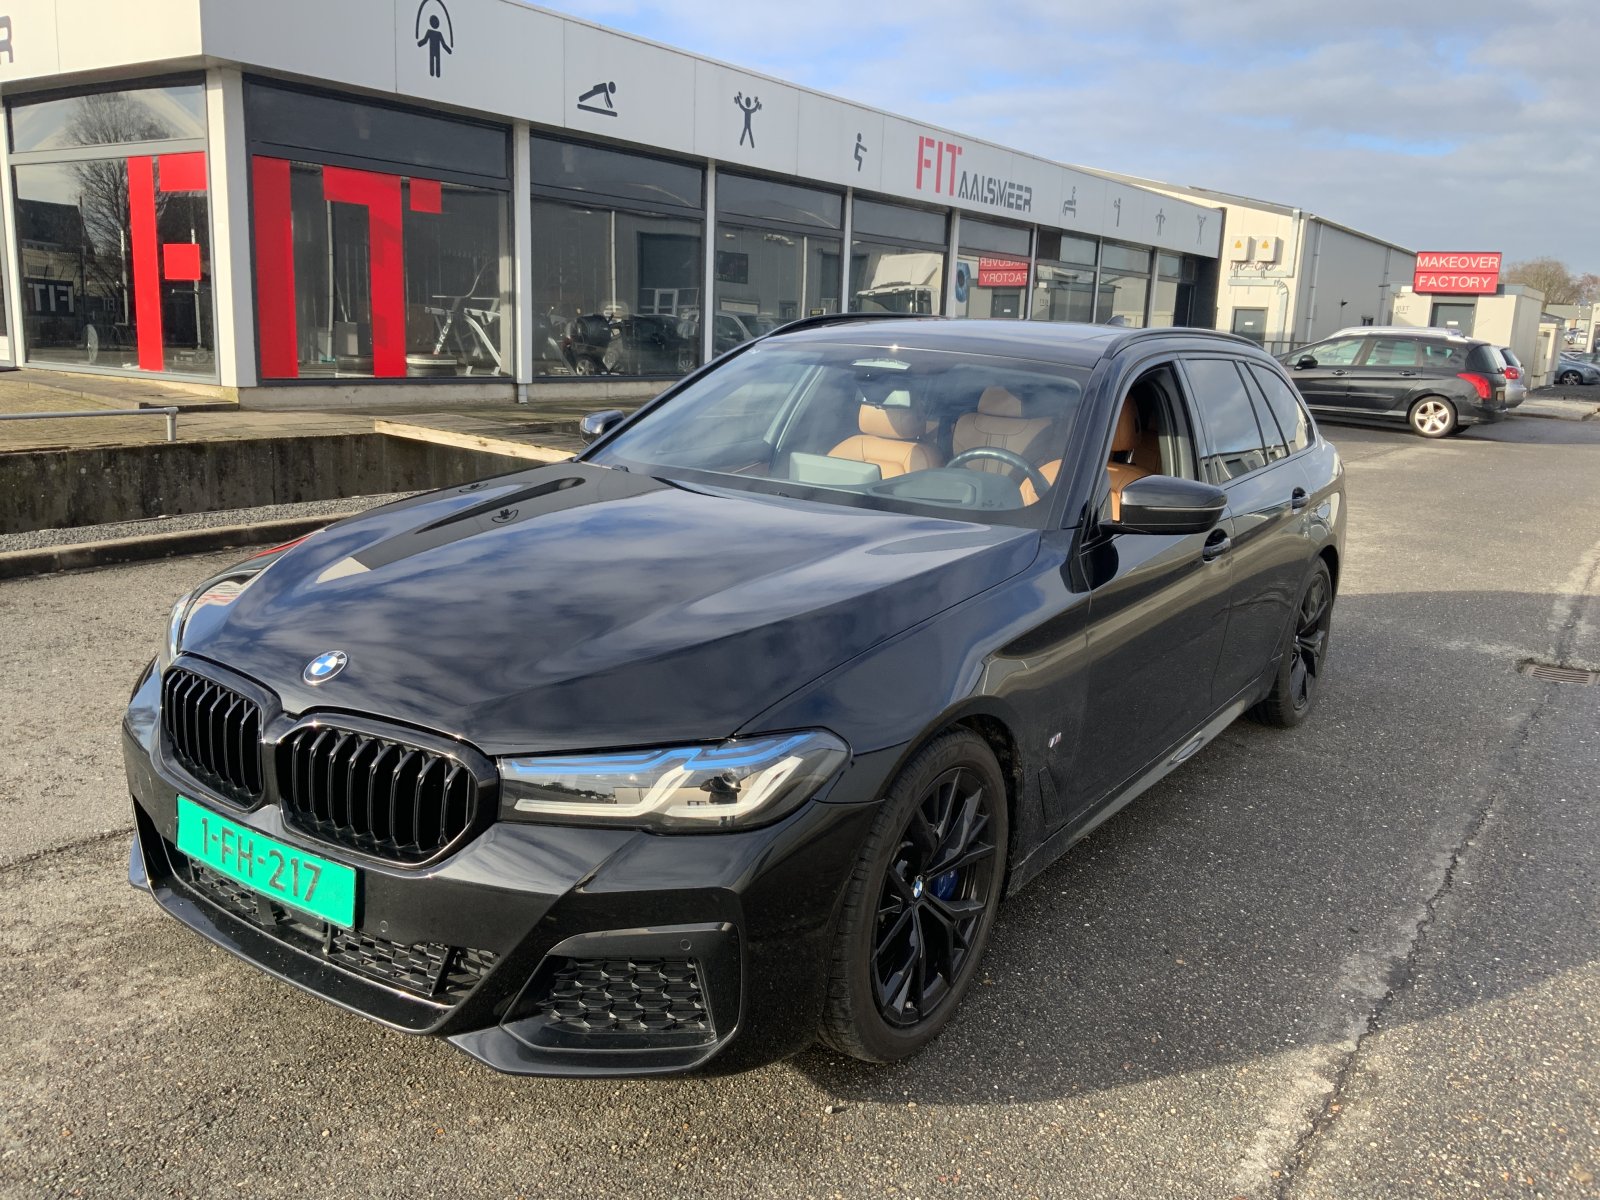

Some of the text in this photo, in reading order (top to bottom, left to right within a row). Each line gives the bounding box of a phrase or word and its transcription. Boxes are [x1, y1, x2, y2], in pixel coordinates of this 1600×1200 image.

[916, 136, 1033, 213] FIT AALSMEER
[1416, 256, 1499, 269] MAKEOVER
[1418, 275, 1492, 288] FACTORY
[201, 817, 322, 902] 1-FH-217
